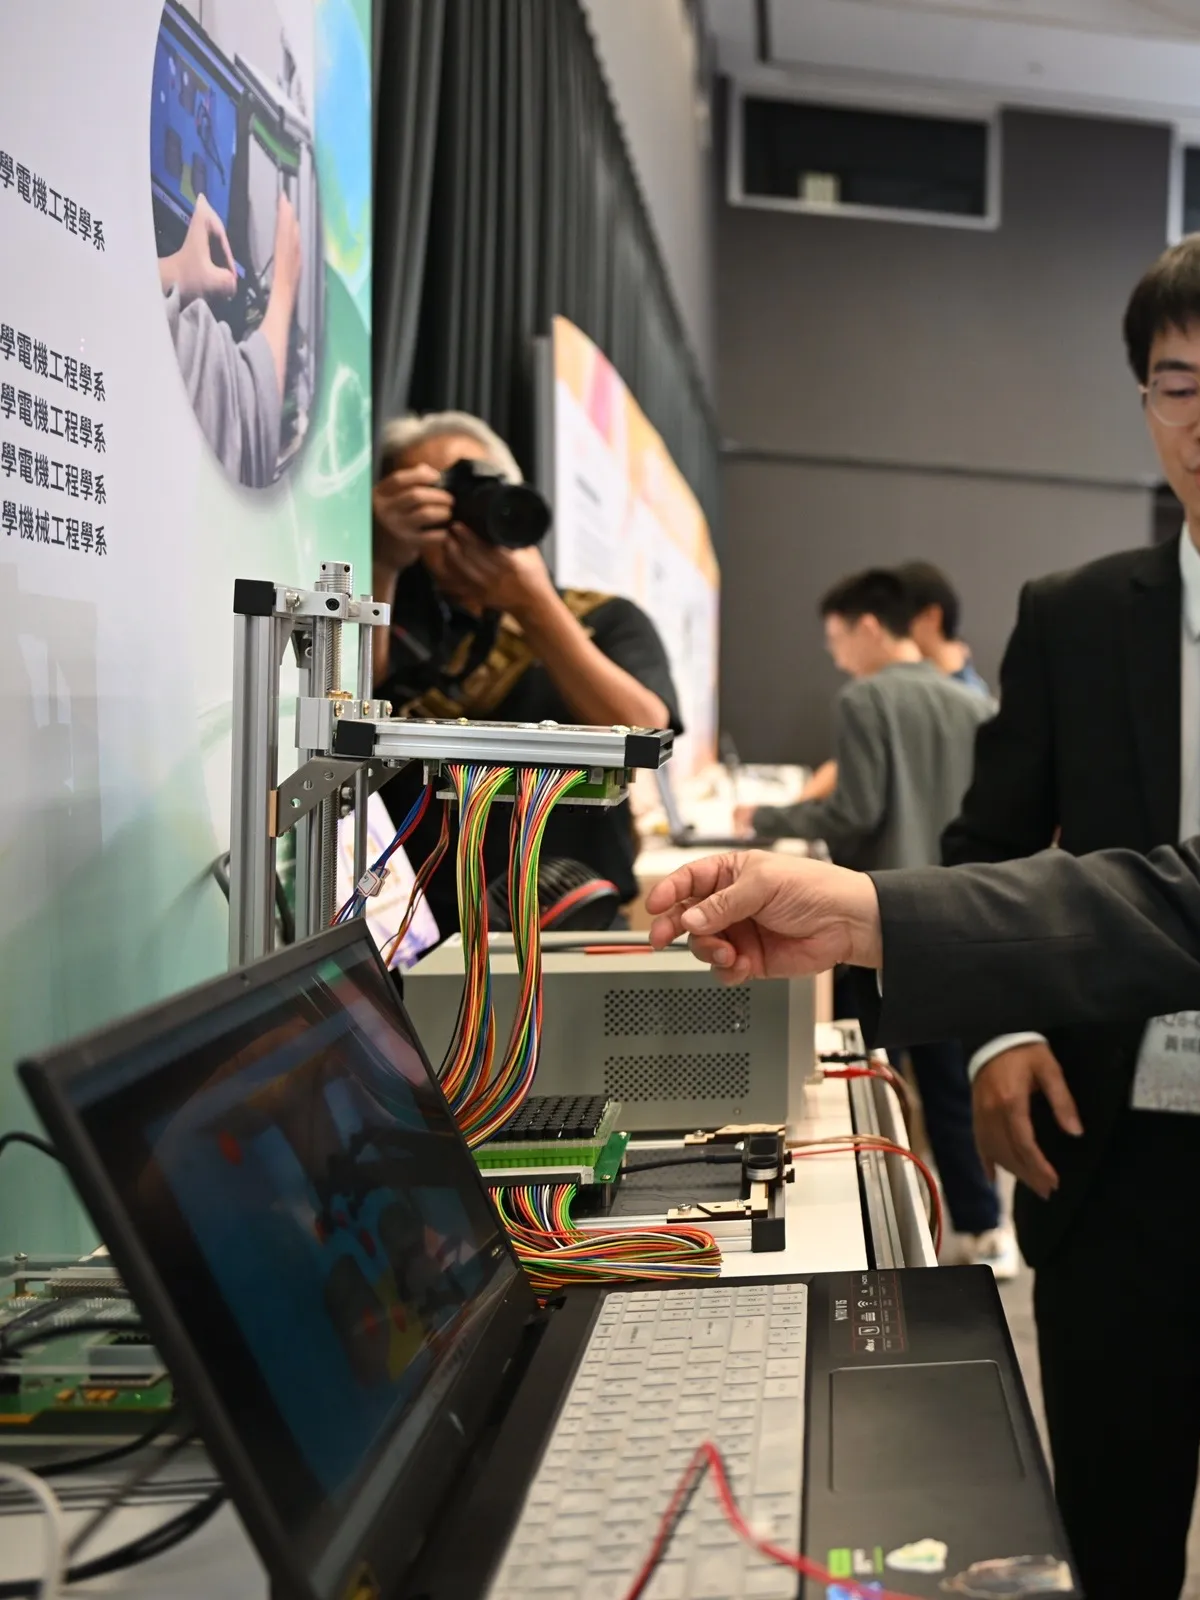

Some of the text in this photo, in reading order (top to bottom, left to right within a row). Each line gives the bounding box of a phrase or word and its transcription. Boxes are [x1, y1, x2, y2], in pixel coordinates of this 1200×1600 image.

[0, 150, 105, 252] 學電機工程學系
[0, 323, 106, 402] 學電機工程學系
[0, 382, 106, 454] 學電機工程學系
[1, 441, 106, 505] 學電機工程學系
[1, 500, 107, 556] 學機械工程學系
